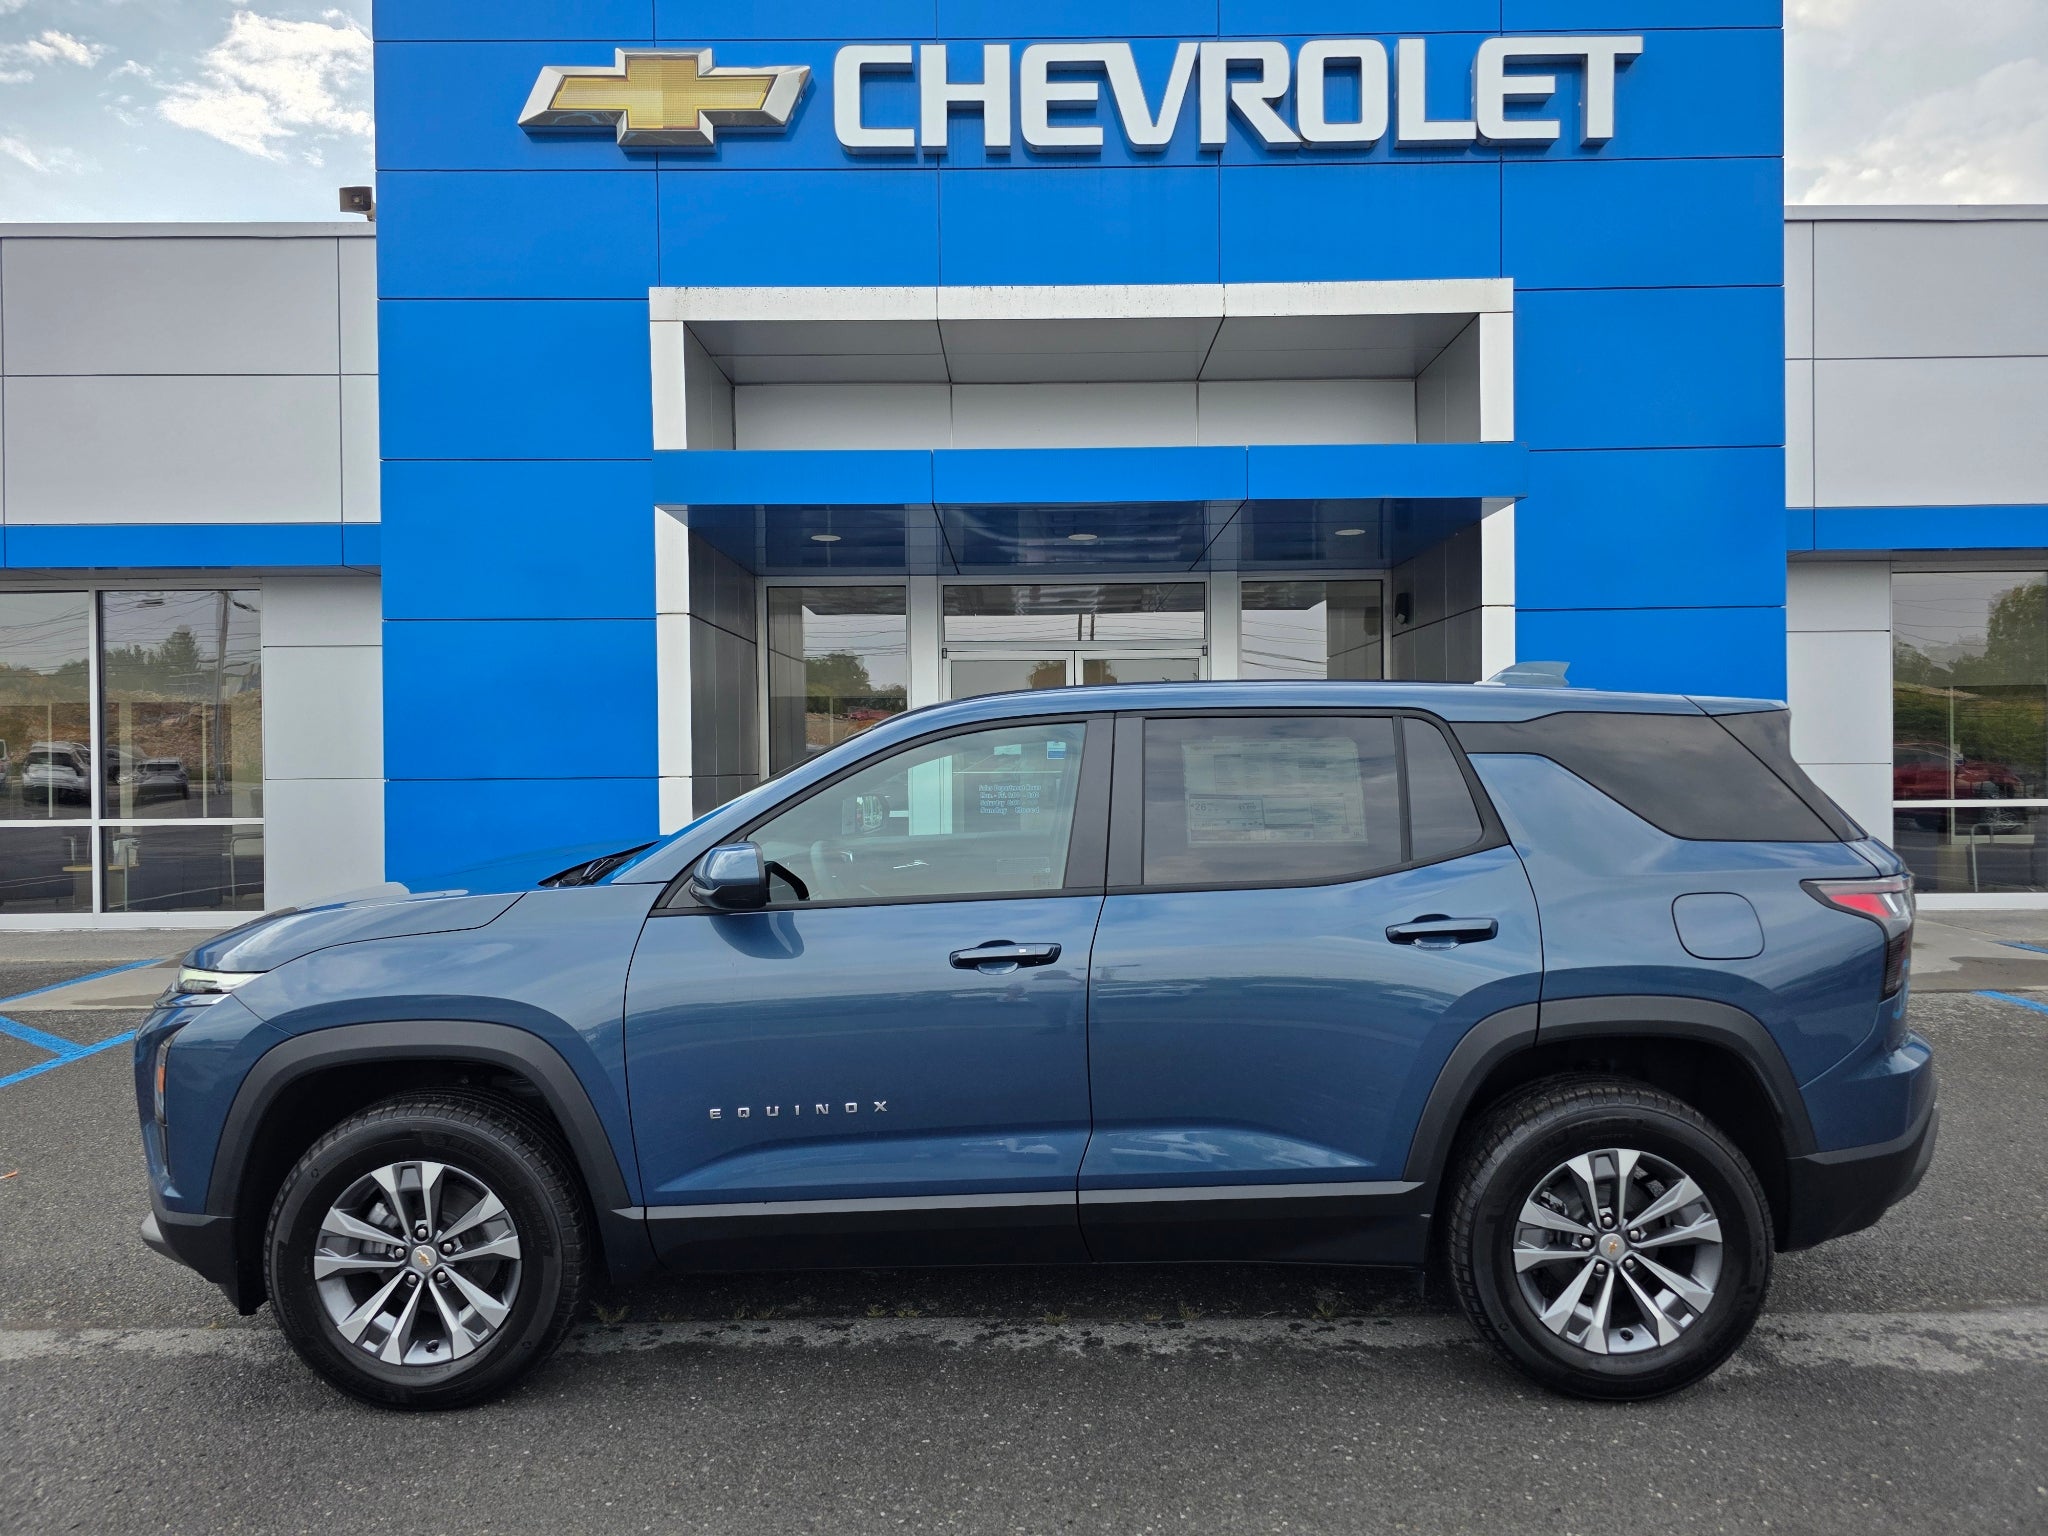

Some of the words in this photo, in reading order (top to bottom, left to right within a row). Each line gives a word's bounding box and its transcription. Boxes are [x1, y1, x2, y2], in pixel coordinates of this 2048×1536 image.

[834, 36, 1644, 150] CHEVROLET
[979, 807, 1008, 815] Sunday
[1014, 806, 1040, 814] Closed
[709, 1101, 887, 1119] EQUINOX
